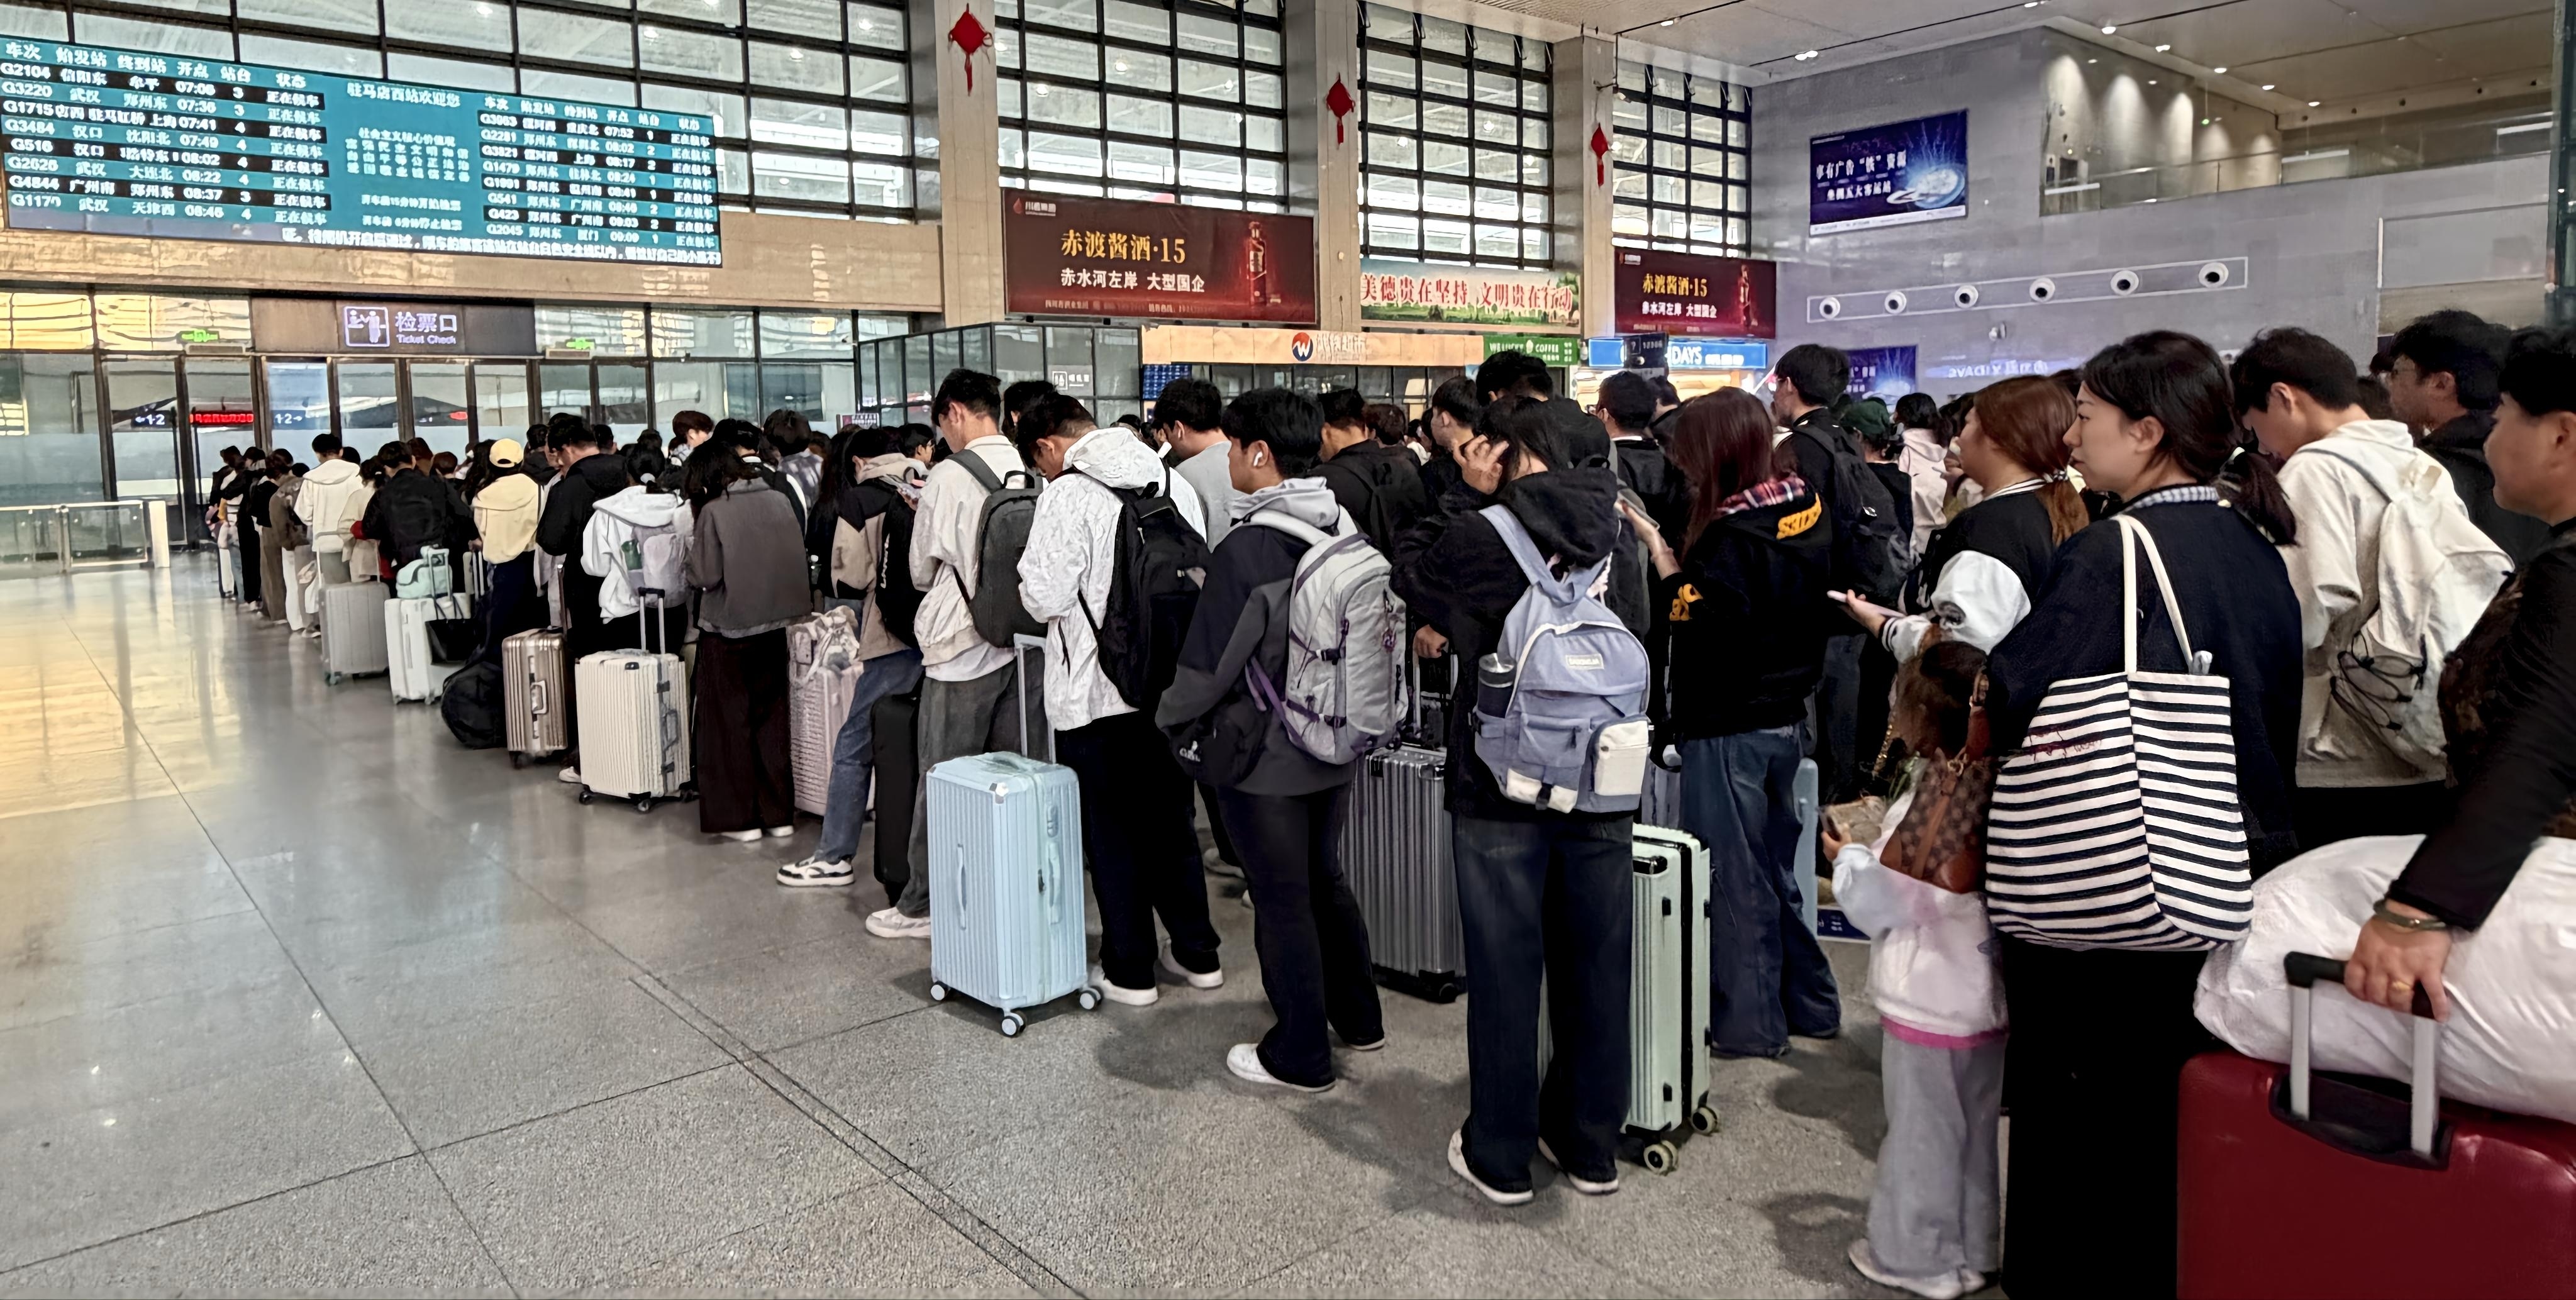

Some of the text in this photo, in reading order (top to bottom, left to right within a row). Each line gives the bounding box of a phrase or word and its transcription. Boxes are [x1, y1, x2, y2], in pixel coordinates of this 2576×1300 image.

[6, 42, 42, 60] 车次
[177, 62, 209, 79] 开点
[0, 62, 51, 79] G2104
[233, 87, 244, 99] 3
[1, 81, 53, 97] G3220
[69, 87, 101, 104] 武汉
[123, 93, 168, 110] 郑州东
[234, 104, 245, 116] 3
[347, 82, 460, 108] 驻马店西站欢迎您
[3, 100, 54, 116] G1715
[179, 116, 217, 131] 07:41
[235, 122, 246, 134] 4
[72, 125, 103, 139] 汉口
[126, 129, 171, 145] 沈阳北
[179, 135, 219, 148] 07:49
[236, 139, 247, 151] 4
[647, 130, 654, 141] 1
[74, 143, 104, 157] 汉口
[182, 152, 220, 166] 08:02
[238, 157, 248, 168] 4
[647, 145, 655, 156] 2
[75, 161, 106, 177] 武汉
[129, 165, 173, 181] 大连北
[182, 170, 221, 184] 08:22
[239, 174, 249, 186] 4
[647, 160, 656, 170] 2
[69, 180, 115, 195] 广州南
[131, 184, 174, 199] 郑州东
[183, 187, 223, 201] 08:37
[240, 191, 251, 202] 3
[649, 175, 655, 186] 1
[650, 189, 657, 199] 1
[79, 197, 109, 213] 武汉
[241, 208, 252, 220] 4
[650, 204, 658, 215] 2
[650, 219, 658, 230] 2
[652, 233, 658, 244] 1
[1061, 268, 1205, 292] 赤水河左岸 大型国企
[1361, 274, 1572, 311] 美德贵在坚持 文明贵在行动
[395, 311, 457, 332] 检票口
[396, 334, 456, 344] Ticket Check
[1536, 344, 1559, 353] COFFEE
